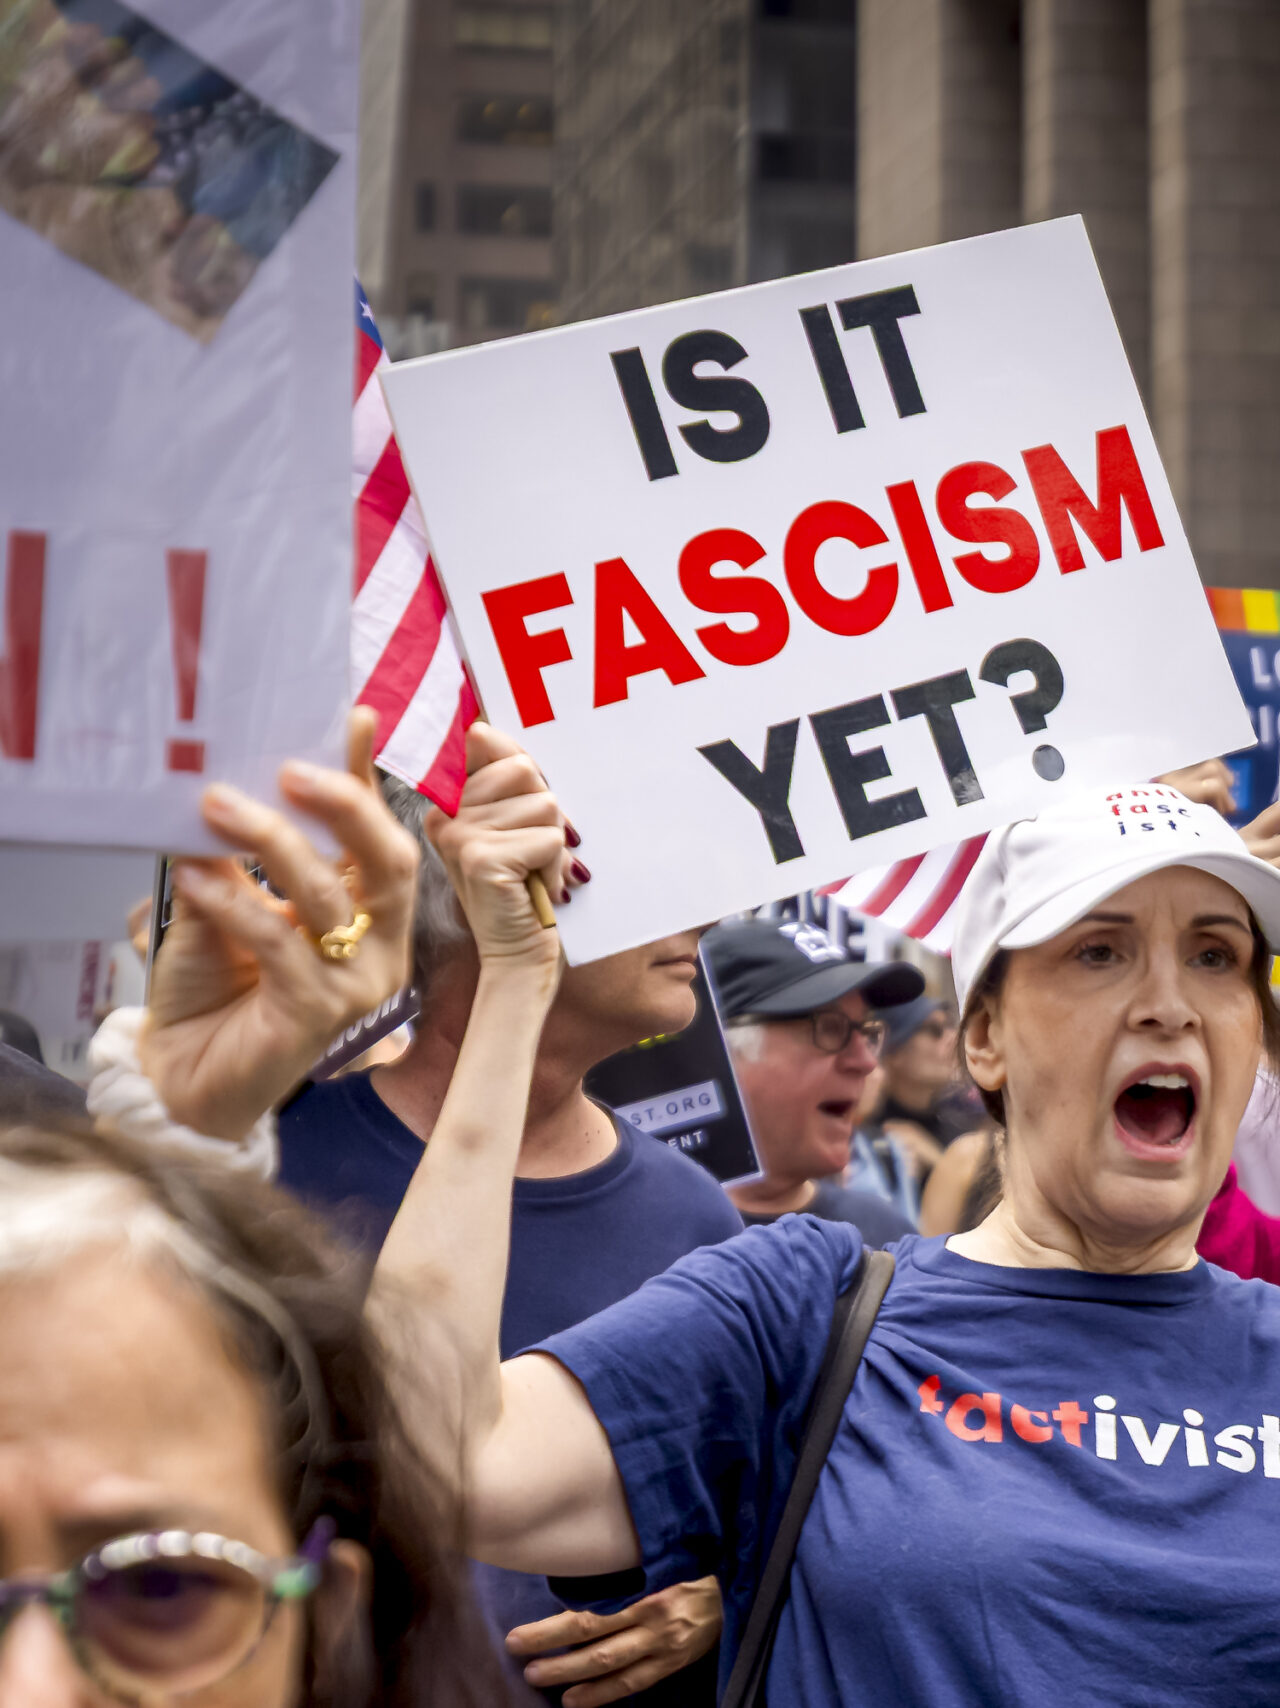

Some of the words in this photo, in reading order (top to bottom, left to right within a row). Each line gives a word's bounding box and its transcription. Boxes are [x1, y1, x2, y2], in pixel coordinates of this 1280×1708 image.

[610, 329, 770, 481] IS
[798, 284, 927, 434] IT
[481, 425, 1165, 728] FASCISM
[696, 638, 1065, 865] YET?
